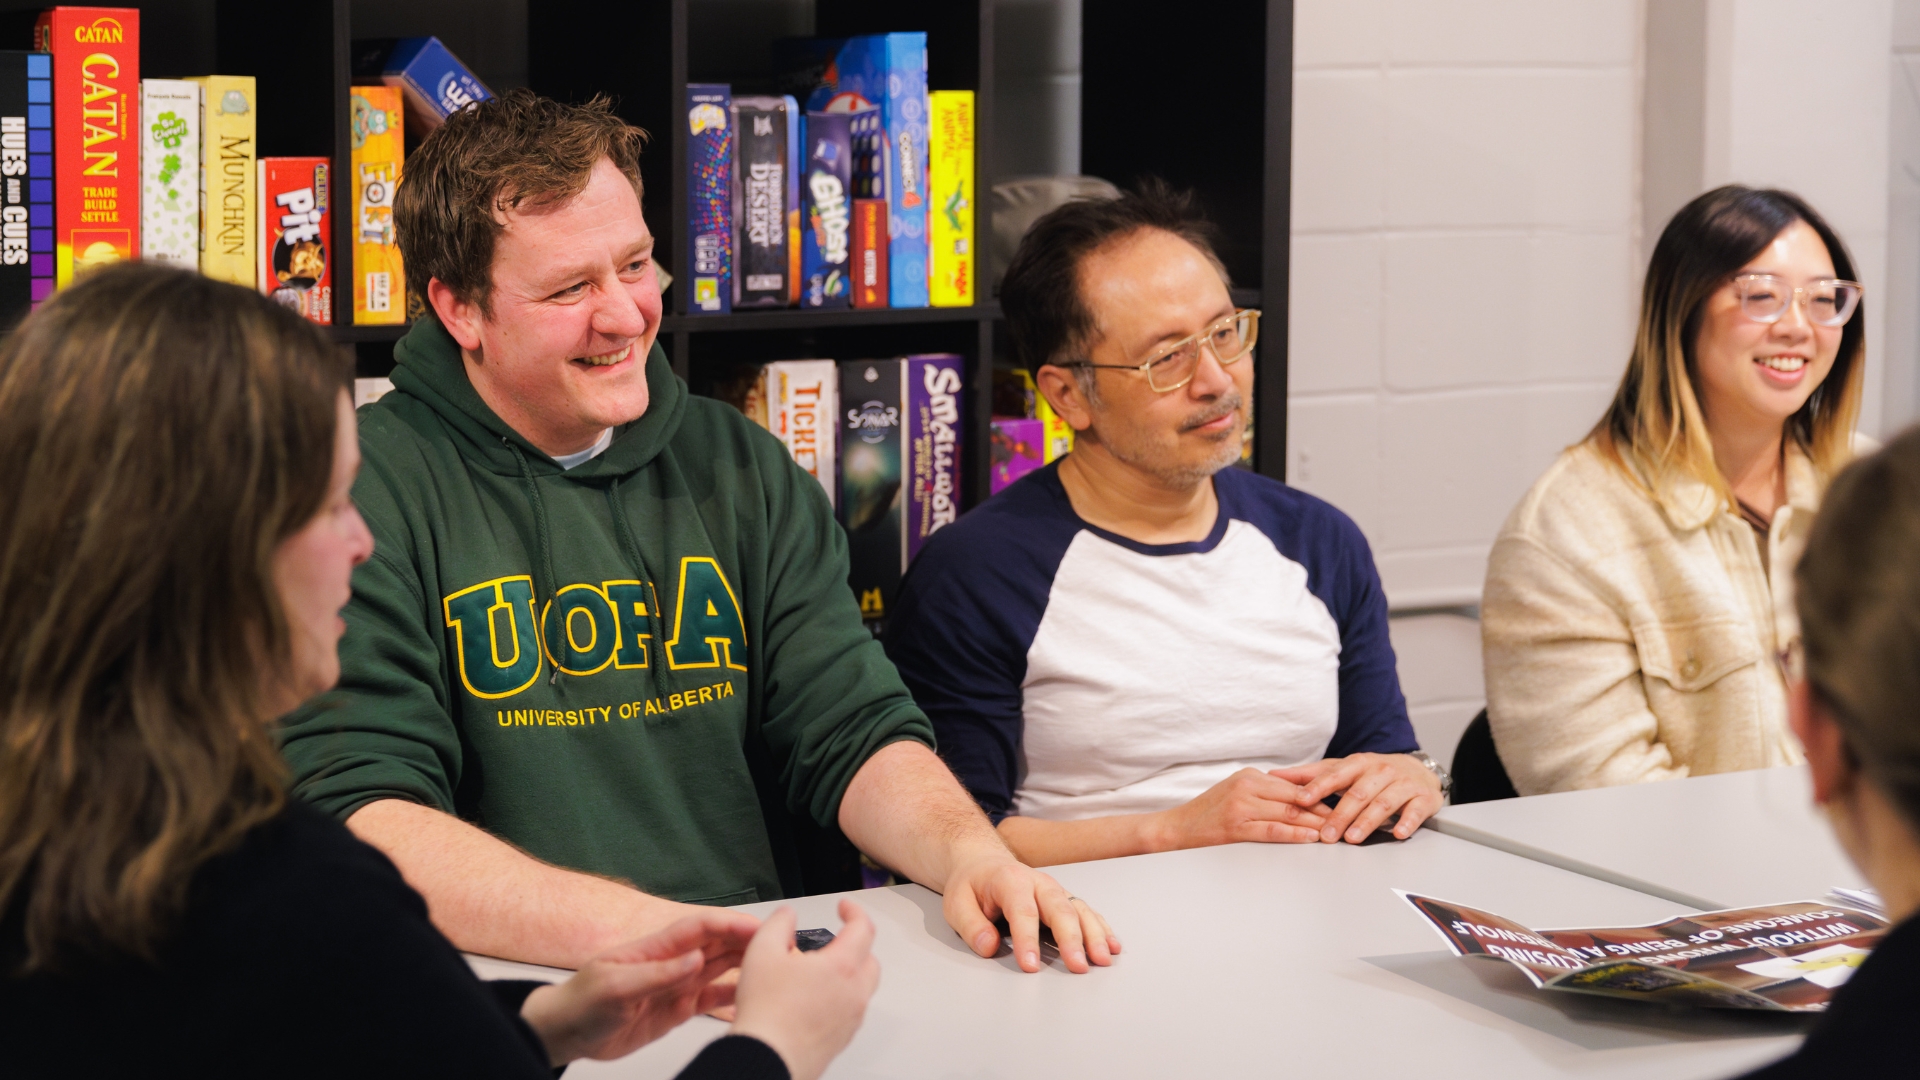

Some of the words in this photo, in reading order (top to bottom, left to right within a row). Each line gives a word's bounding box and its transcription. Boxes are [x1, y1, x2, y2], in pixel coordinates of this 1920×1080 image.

[75, 25, 123, 43] CATAN
[82, 53, 119, 178] CATAN
[1, 116, 27, 176] HUES
[7, 178, 21, 204] AND
[82, 187, 118, 198] TRADE
[220, 135, 251, 257] MUNCHKIN
[769, 163, 783, 245] FORBIDDEN
[81, 211, 119, 223] SETTLE
[84, 199, 117, 210] BUILD
[276, 187, 322, 246] Pit
[363, 163, 393, 246] FORT
[748, 161, 770, 248] DESERT
[809, 174, 849, 263] GHOST
[2, 205, 28, 265] CUES
[923, 364, 962, 536] SMALLWOR
[497, 705, 612, 727] UNIVERSITY
[618, 702, 642, 719] OF
[644, 680, 734, 716] ALBERTA
[1719, 909, 1846, 934] SOMEONE
[1740, 922, 1860, 947] WITHOUT
[1604, 938, 1689, 956] BEING
[1689, 928, 1724, 944] OF
[1486, 944, 1588, 970] CUSING
[1590, 946, 1607, 957] A
[1638, 943, 1747, 964] WRONG
